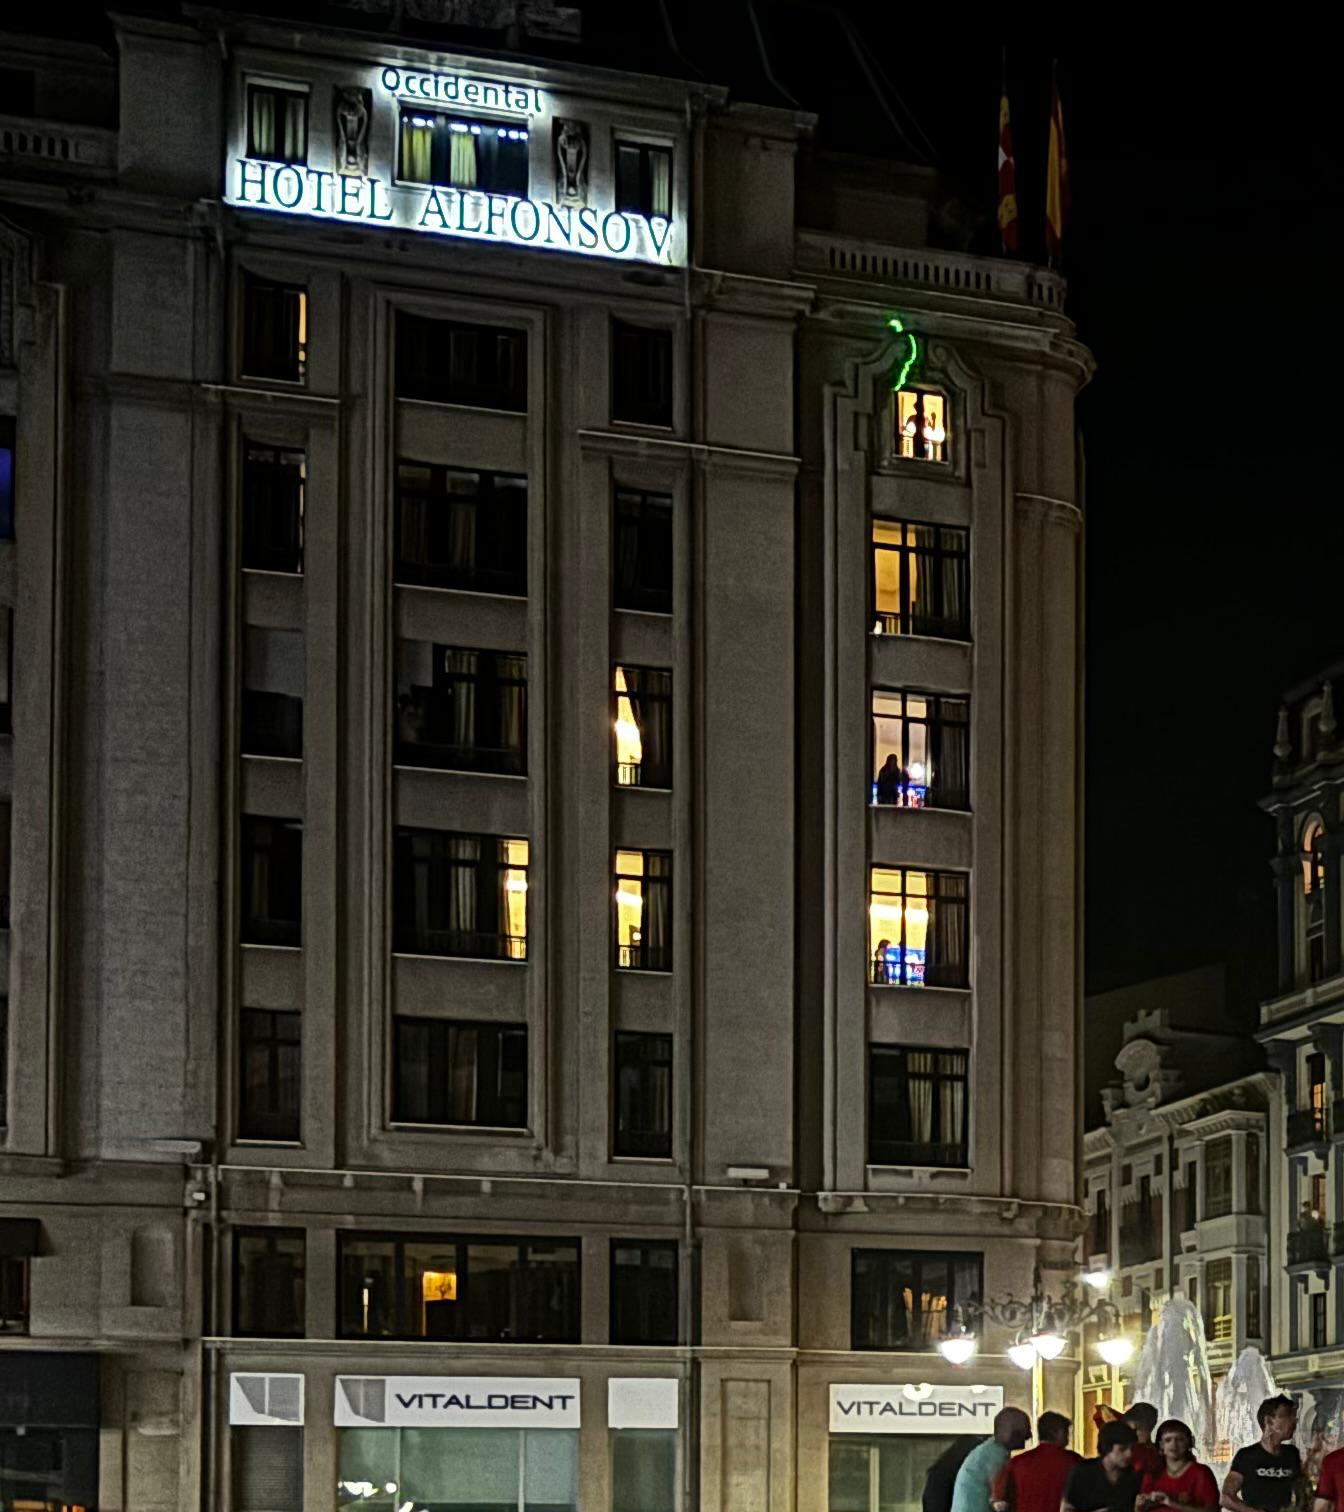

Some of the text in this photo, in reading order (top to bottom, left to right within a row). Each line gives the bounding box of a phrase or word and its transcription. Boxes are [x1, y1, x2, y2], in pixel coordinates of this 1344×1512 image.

[382, 67, 541, 112] Occidental
[236, 158, 674, 257] HOTEL ALFONSO V
[395, 1393, 575, 1410] VITALDENT
[836, 1400, 996, 1417] VITALDENT
